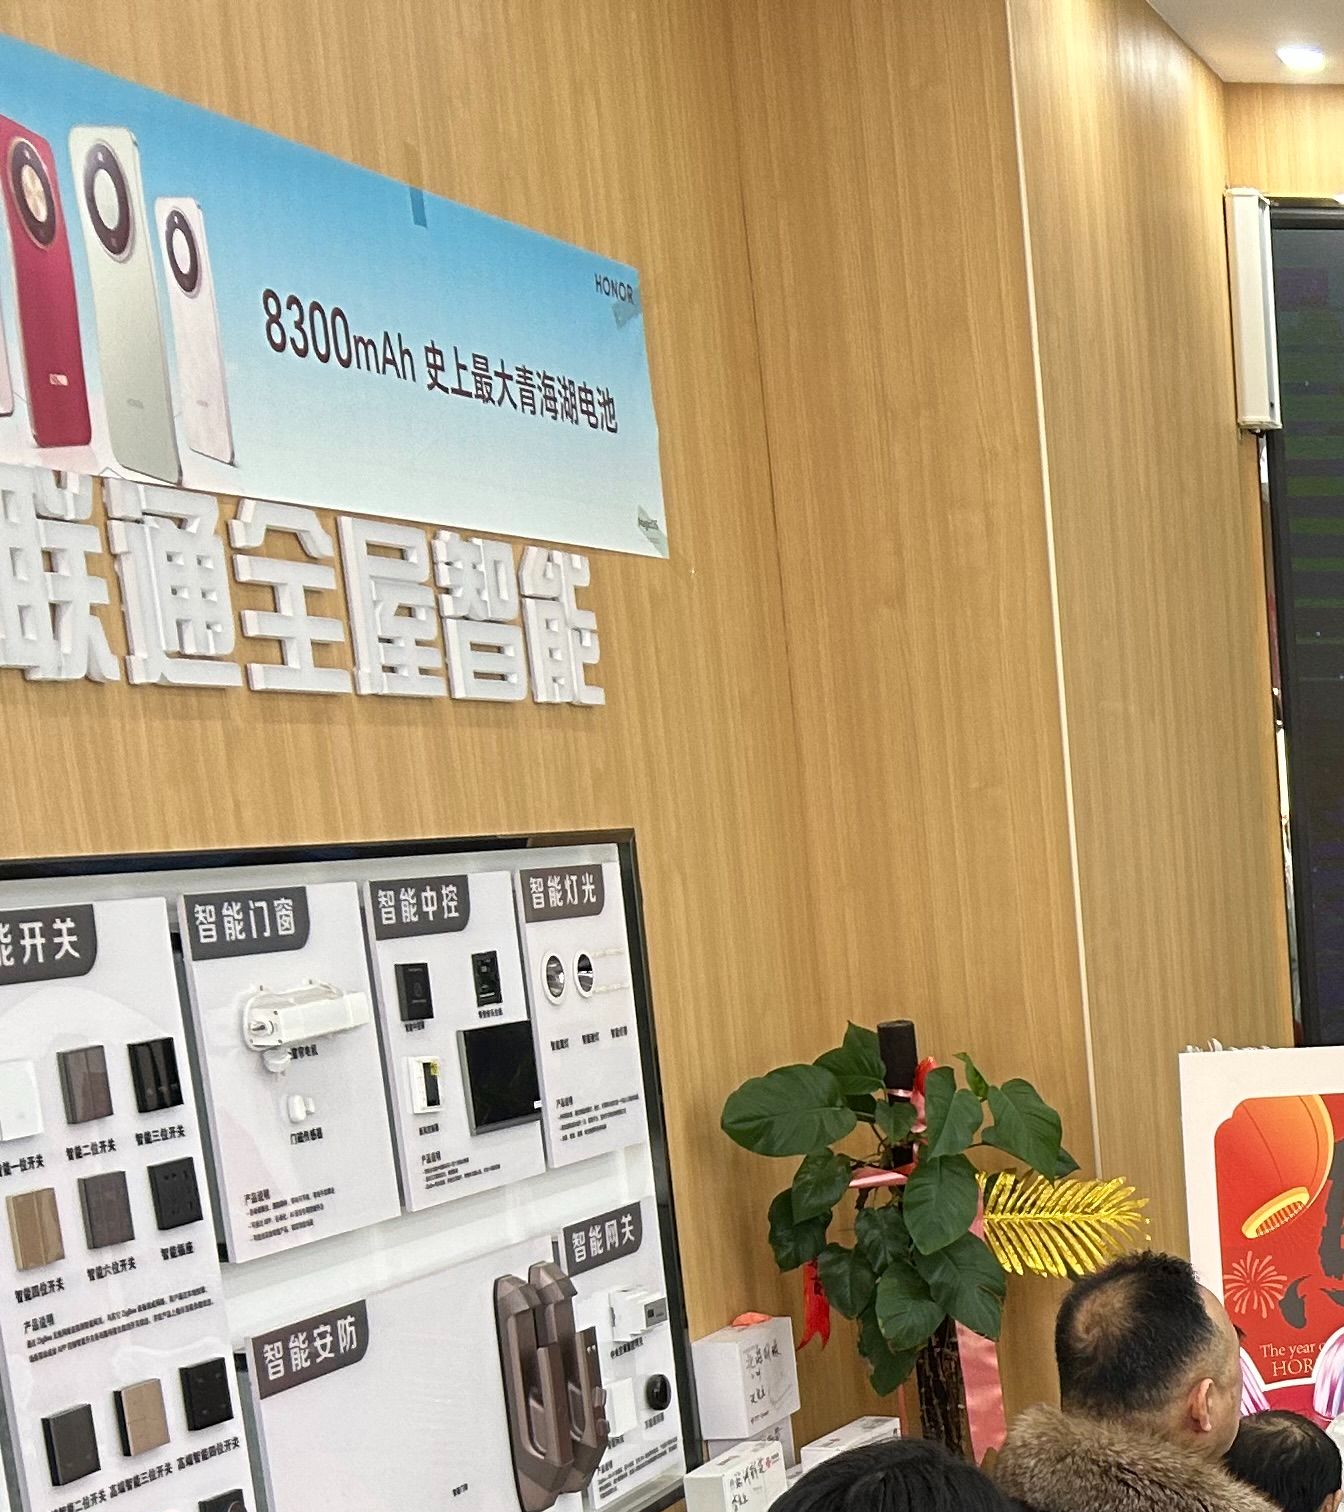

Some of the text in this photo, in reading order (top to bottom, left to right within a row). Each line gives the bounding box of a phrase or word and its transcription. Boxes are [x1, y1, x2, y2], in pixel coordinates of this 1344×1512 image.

[594, 272, 635, 305] HONOR
[261, 287, 619, 434] 8300mAh 史上最大青海湖电池
[377, 884, 460, 925] 智能中控
[529, 872, 597, 910] 智能灯光
[194, 897, 296, 944] 智能门窗
[572, 1213, 635, 1263] 智能网关
[263, 1315, 358, 1381] 智能安防
[1260, 1343, 1315, 1360] The year
[1272, 1359, 1314, 1377] HOR
